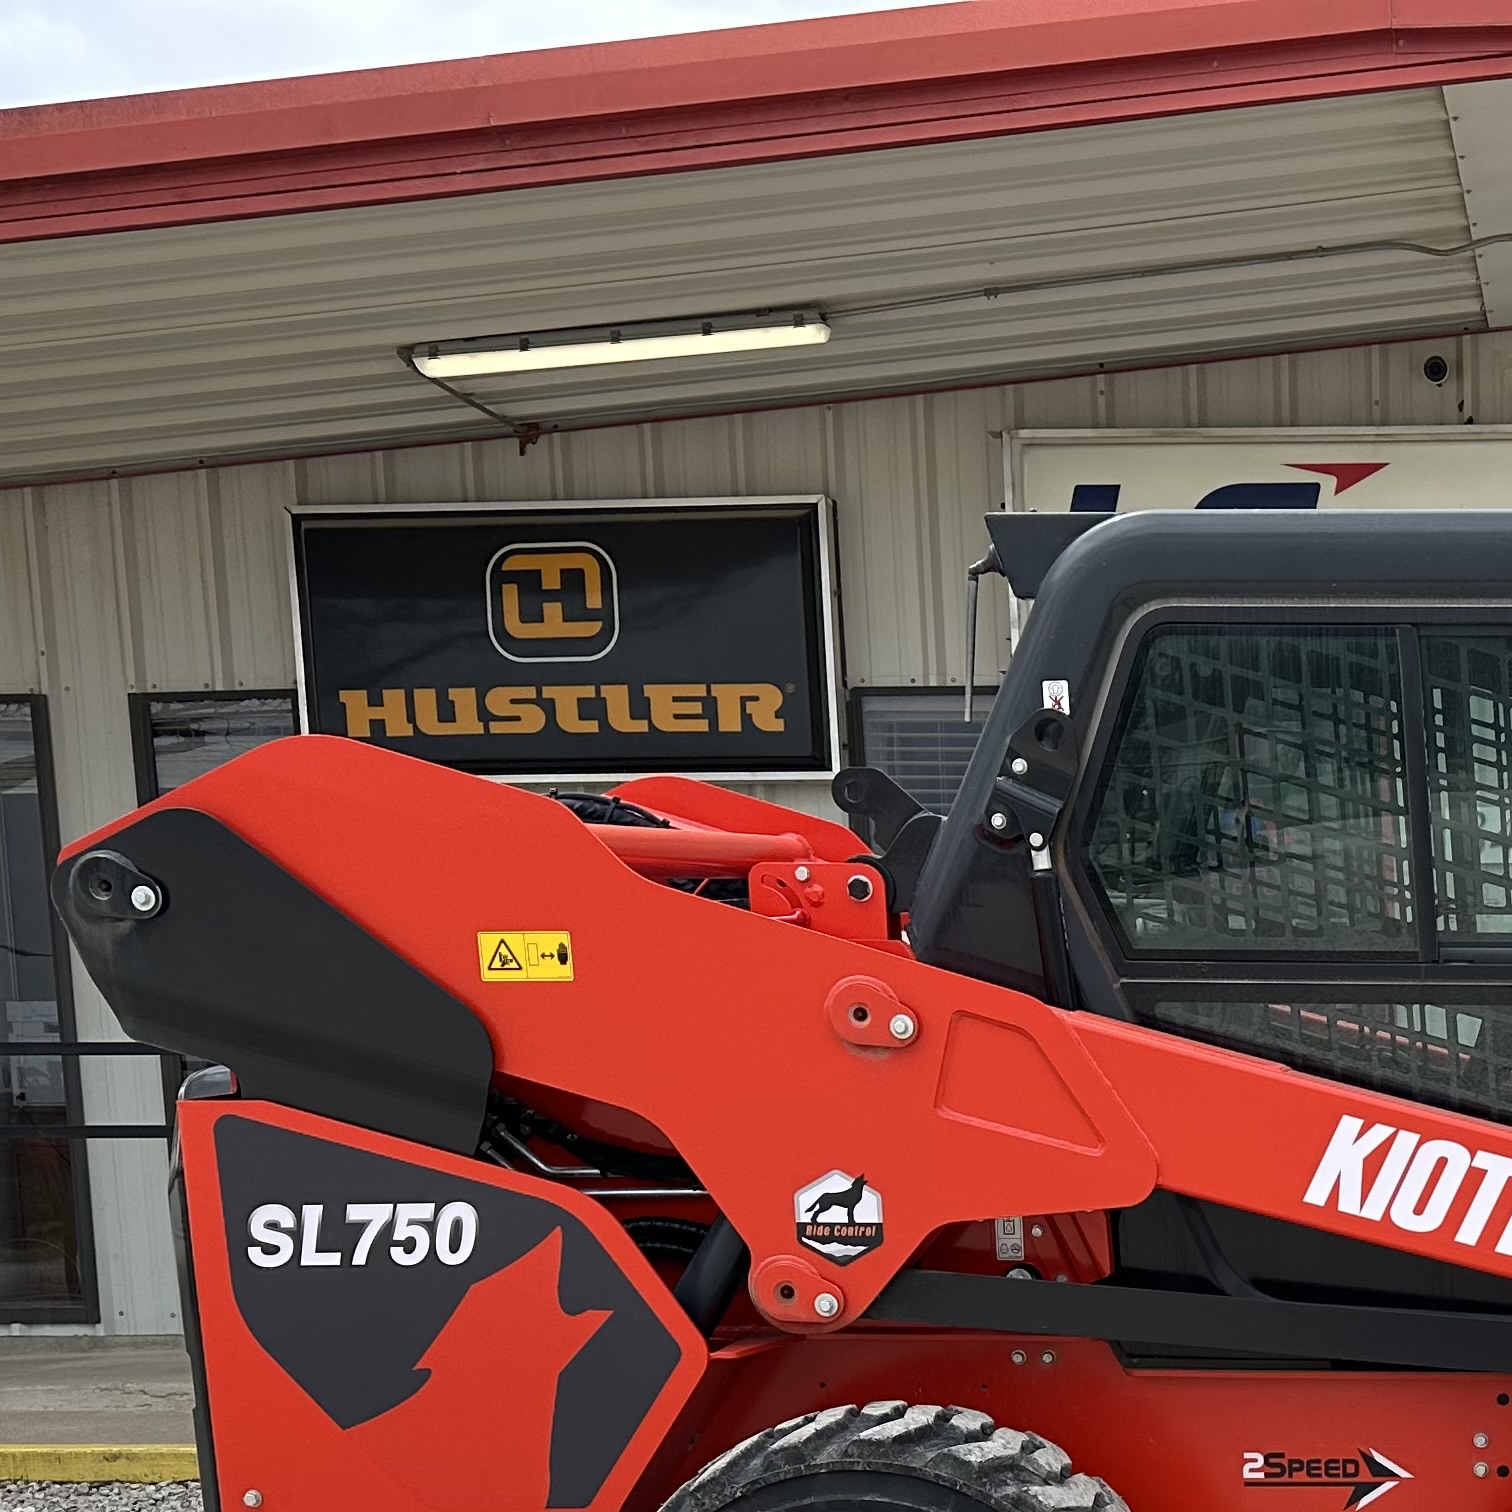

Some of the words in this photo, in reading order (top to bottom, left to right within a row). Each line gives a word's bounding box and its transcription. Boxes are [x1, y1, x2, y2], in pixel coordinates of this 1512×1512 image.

[339, 682, 785, 738] HUSTLER
[247, 1201, 479, 1268] SL750
[805, 1225, 830, 1237] Ride
[833, 1225, 876, 1237] Control
